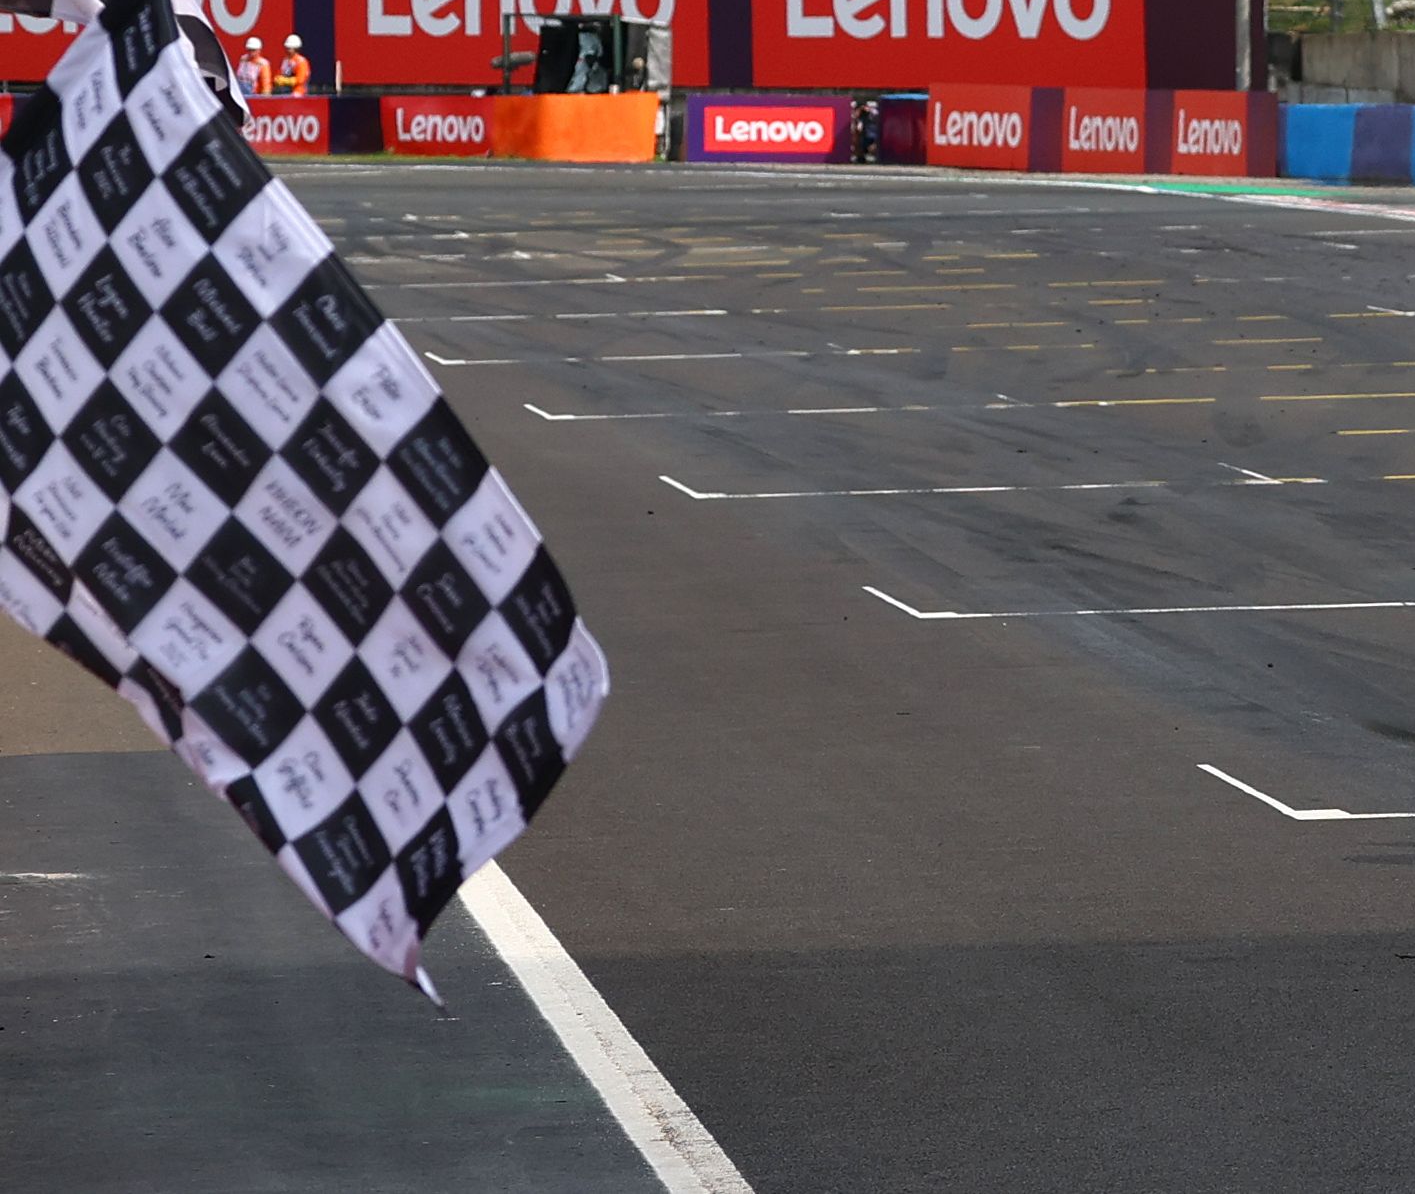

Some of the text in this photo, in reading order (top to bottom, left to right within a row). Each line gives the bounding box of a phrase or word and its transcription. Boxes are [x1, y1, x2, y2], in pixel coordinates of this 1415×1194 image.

[241, 111, 320, 143] enovo
[397, 108, 484, 143] Lenovo
[715, 115, 824, 144] Lenovo
[934, 102, 1022, 148] Lenovo
[1068, 106, 1139, 152] Lenovo
[1178, 110, 1242, 155] Lenovo
